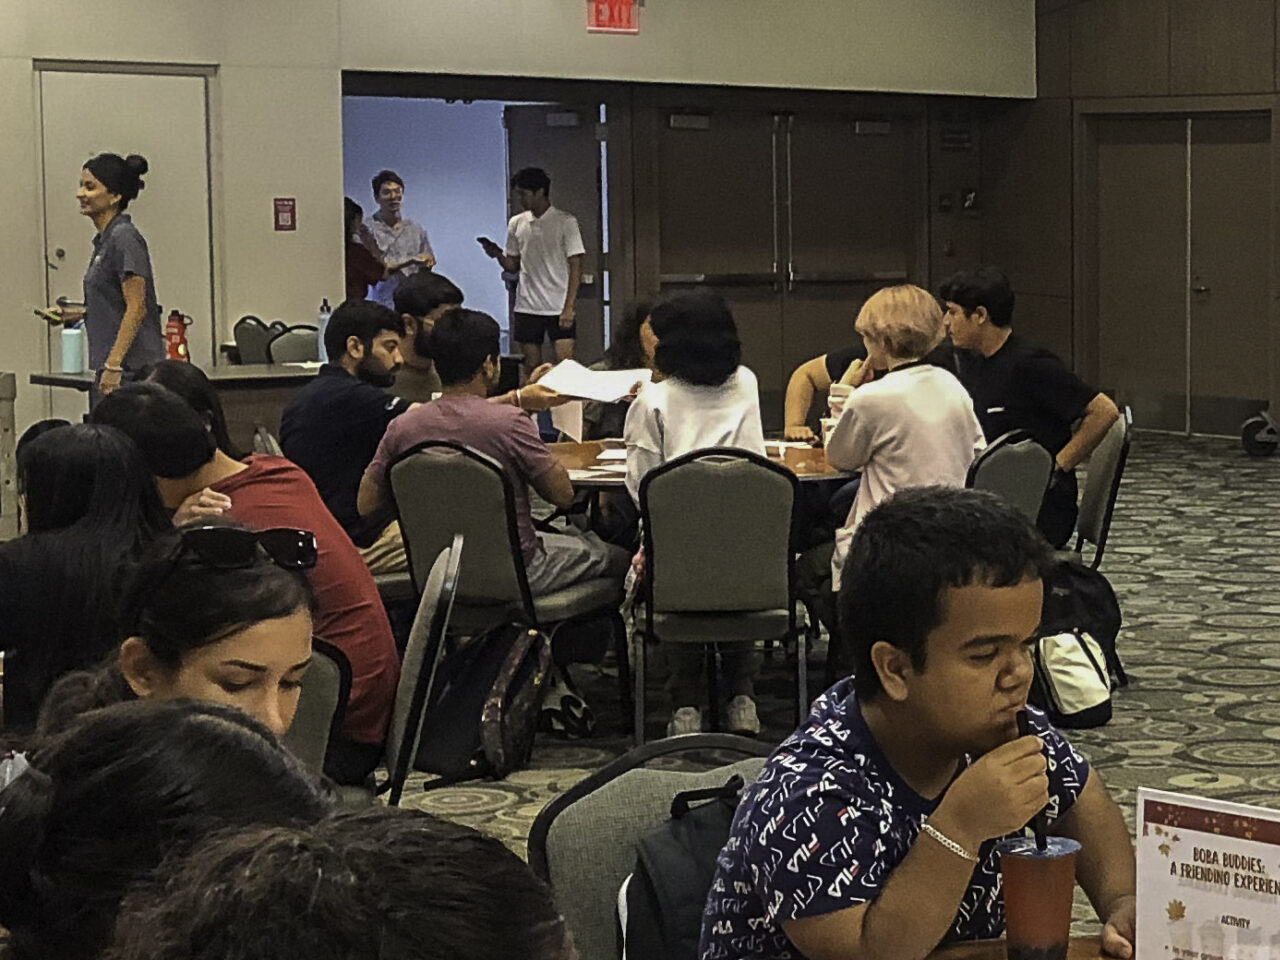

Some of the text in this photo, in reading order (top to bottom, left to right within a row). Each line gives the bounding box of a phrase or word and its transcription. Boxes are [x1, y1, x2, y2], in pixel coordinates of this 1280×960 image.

[594, 0, 632, 28] EXIT
[772, 752, 807, 772] FILA
[759, 806, 786, 846] FILA
[787, 832, 820, 873] FILA
[1193, 847, 1265, 874] BOBA BUDDIES:
[828, 858, 860, 897] FILA
[1170, 861, 1177, 876] A
[1221, 915, 1250, 929] ACTIVITY
